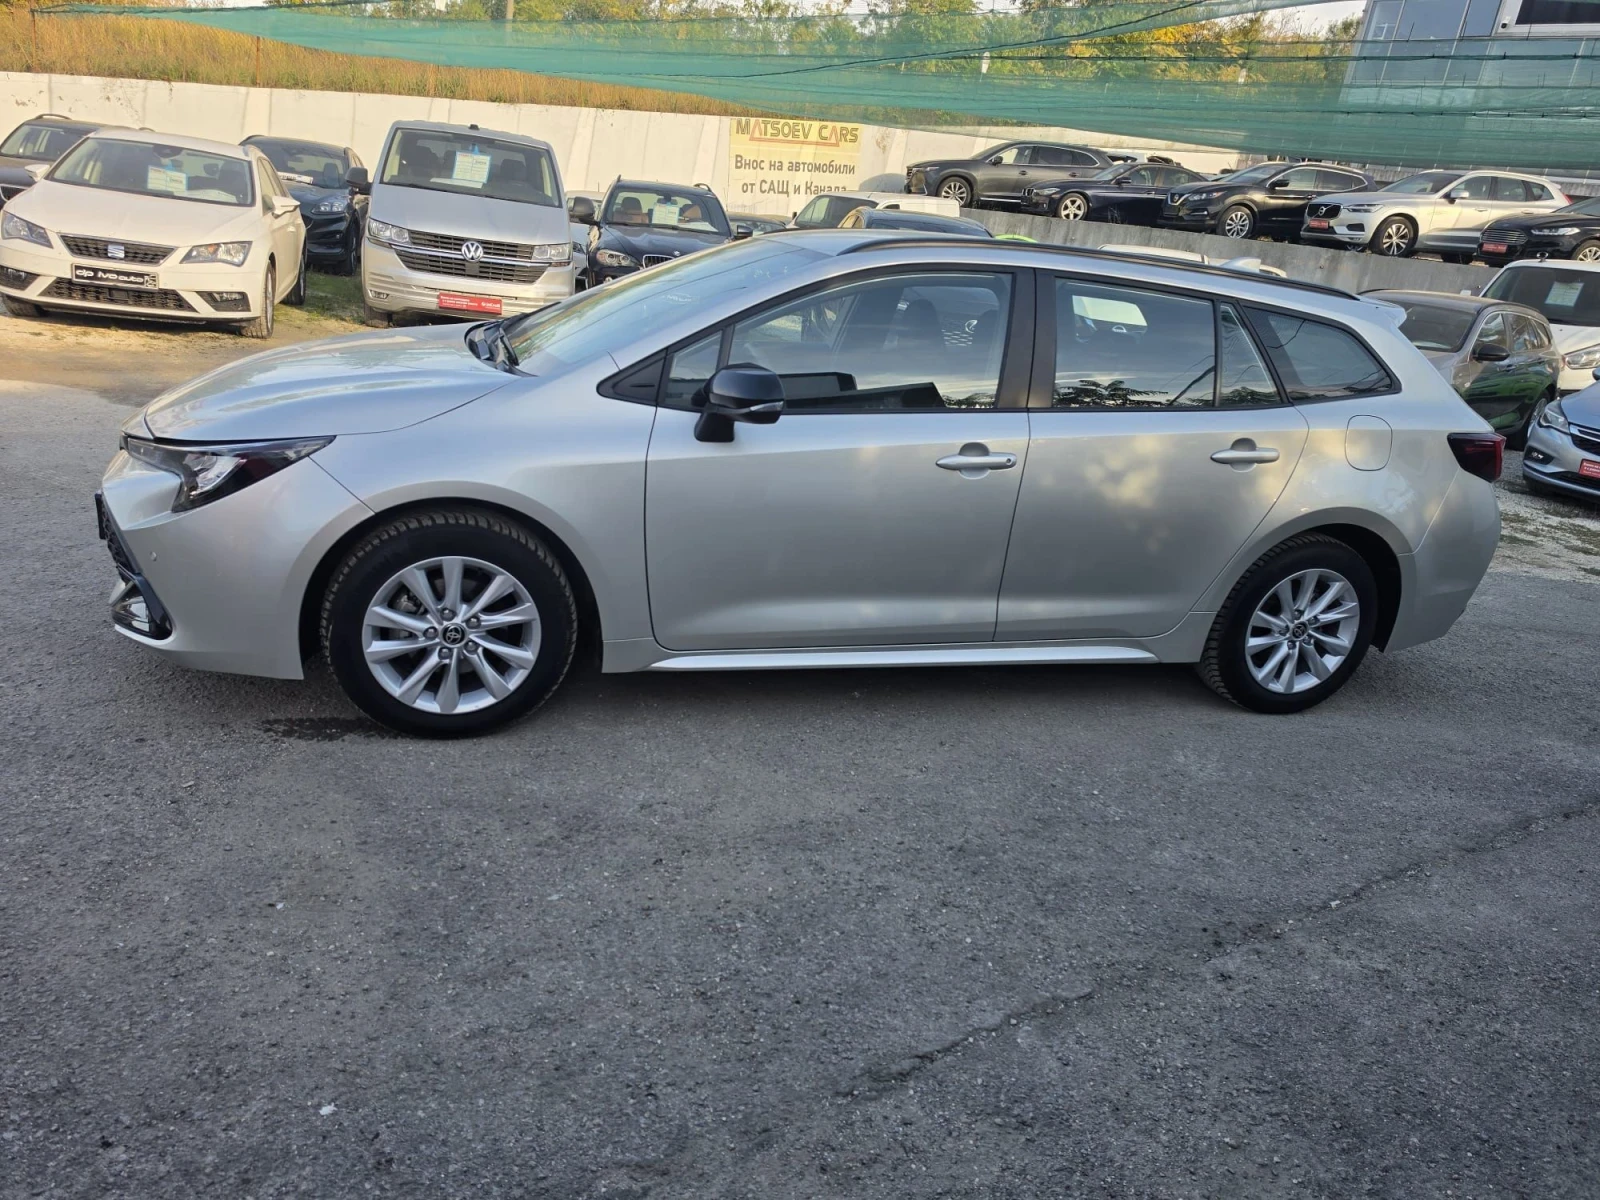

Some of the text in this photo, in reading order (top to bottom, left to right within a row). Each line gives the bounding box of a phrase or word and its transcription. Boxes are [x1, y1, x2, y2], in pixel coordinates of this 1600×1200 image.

[736, 118, 859, 143] MATSOEV CARS
[735, 154, 855, 175] Внос на автомобили
[742, 181, 756, 193] от
[759, 179, 789, 197] САЩ
[793, 185, 801, 195] и
